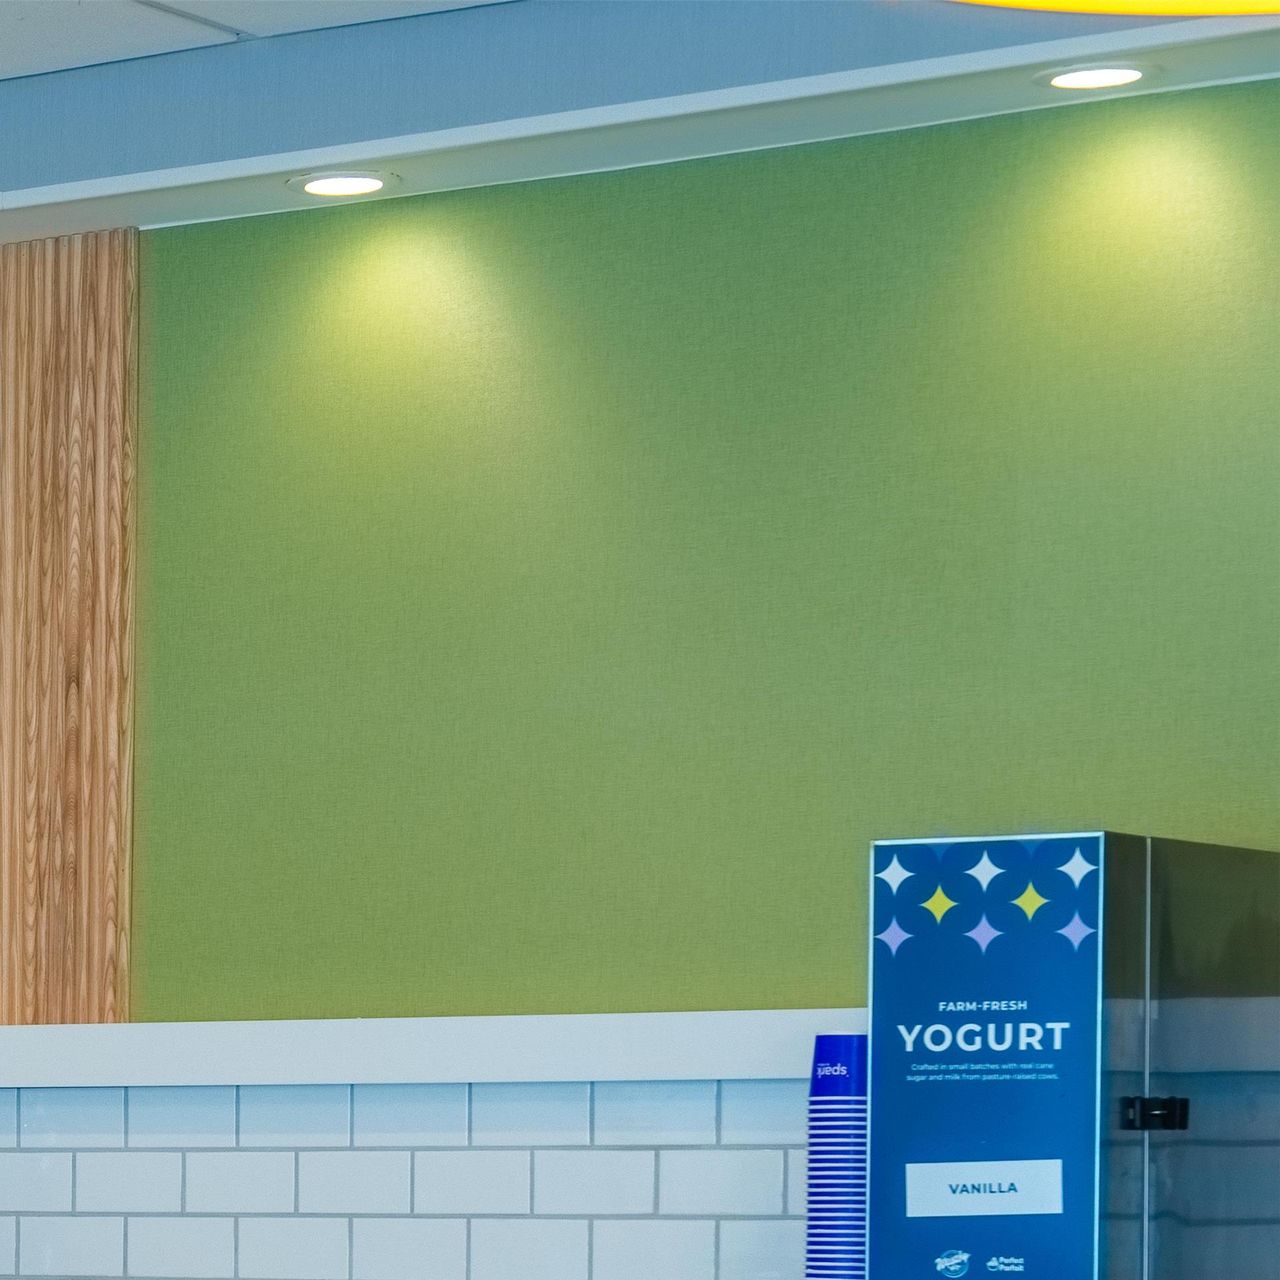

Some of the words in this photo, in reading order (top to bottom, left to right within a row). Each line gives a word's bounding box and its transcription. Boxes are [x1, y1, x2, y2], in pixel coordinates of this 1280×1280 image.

[938, 1000, 1028, 1012] FARM-FRESH
[896, 1022, 1071, 1052] YOGURT
[948, 1182, 1018, 1194] VANILLA
